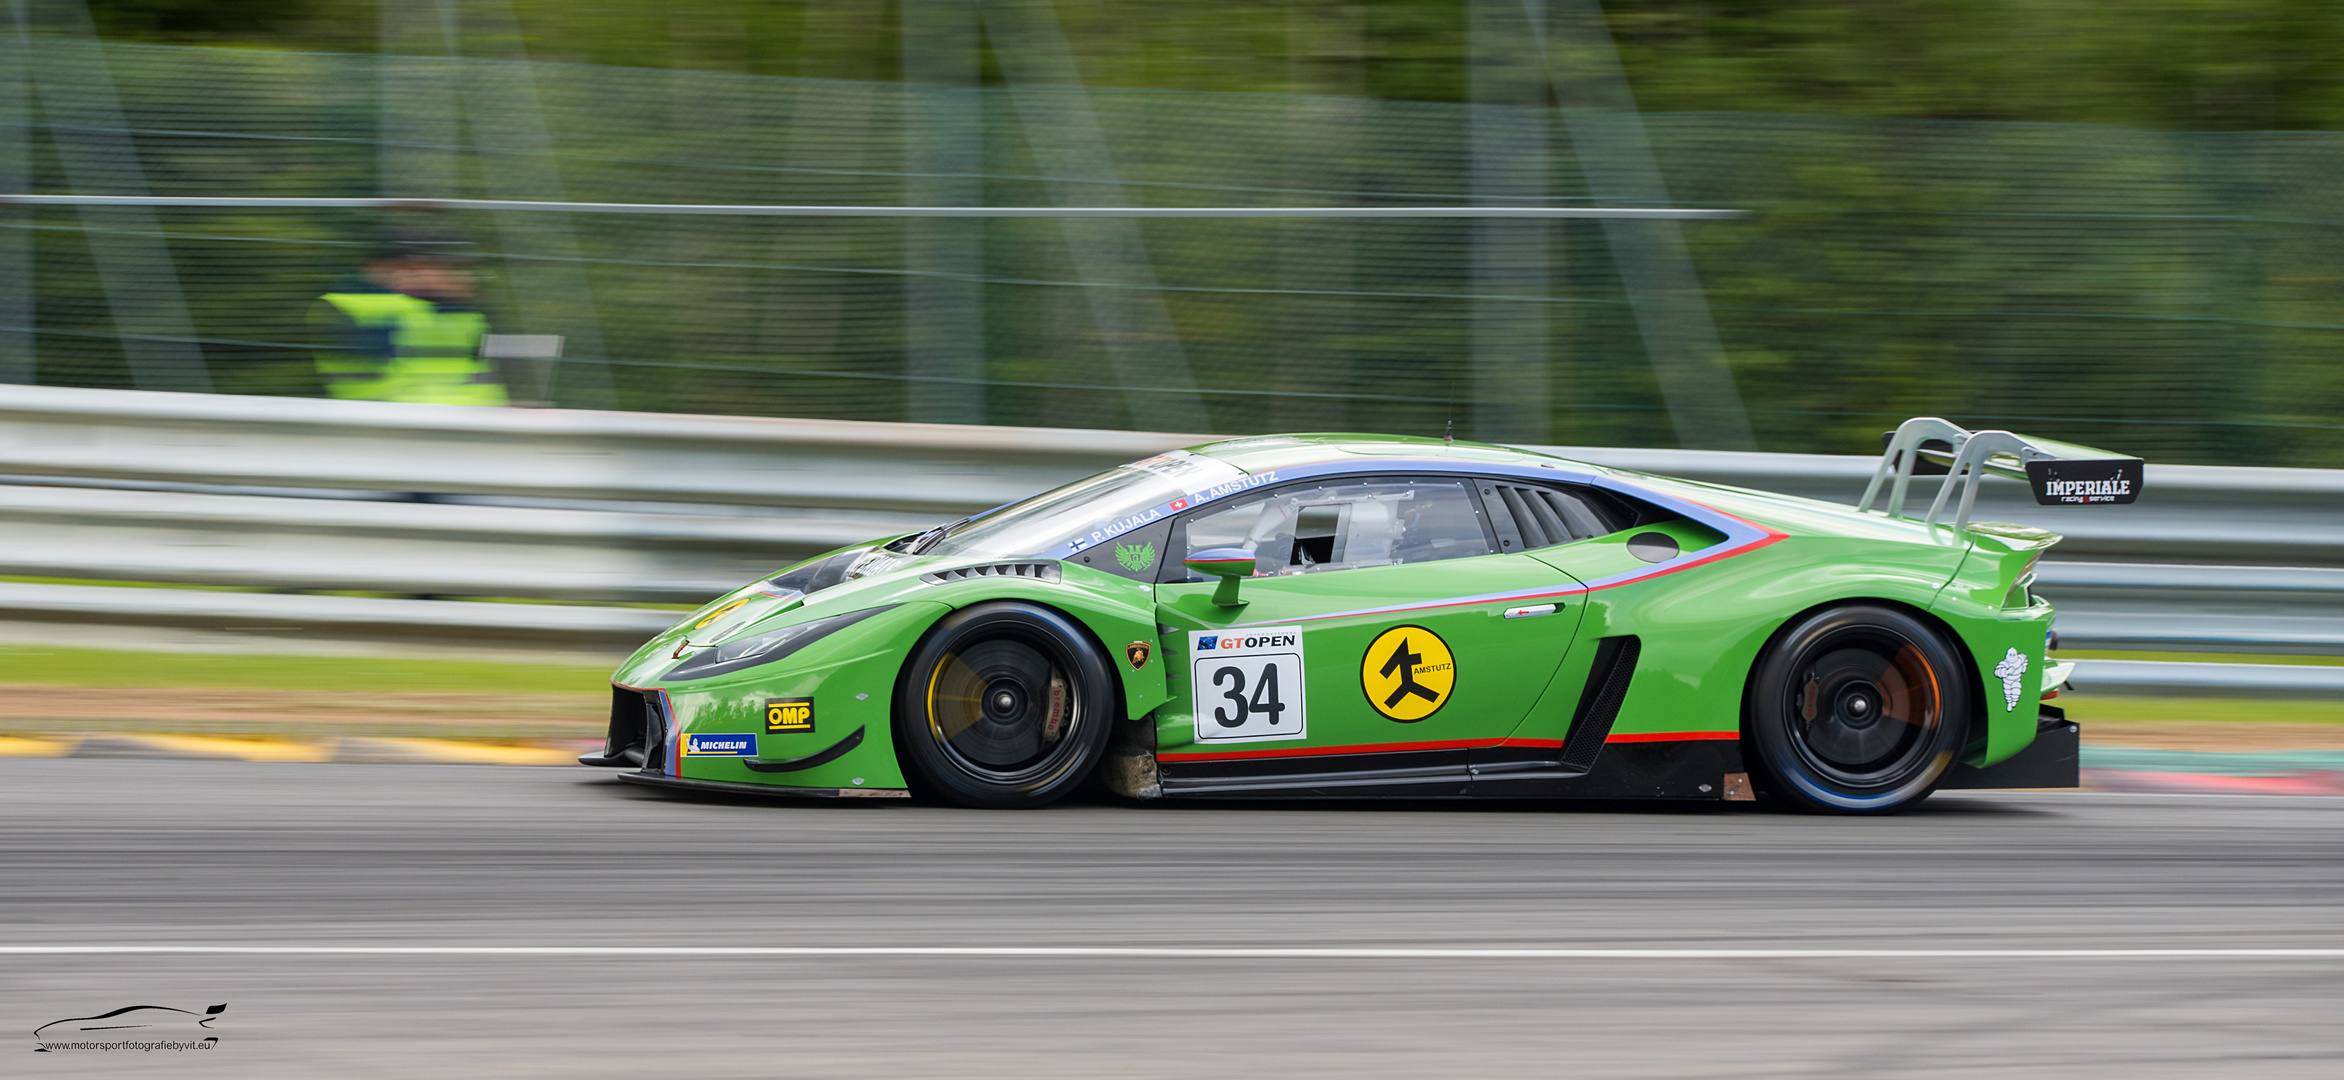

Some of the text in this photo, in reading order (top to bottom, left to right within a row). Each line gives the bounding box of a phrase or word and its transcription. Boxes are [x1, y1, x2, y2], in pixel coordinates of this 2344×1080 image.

[1210, 471, 1279, 498] AMSTUTZ
[2046, 480, 2131, 496] IMPERIALE
[1105, 508, 1161, 536] KUJALA
[1413, 662, 1452, 675] AMSTUTZ
[1213, 663, 1286, 728] 34
[768, 707, 810, 725] OMP
[1048, 689, 1062, 731] brembo
[700, 741, 747, 750] MICHELIN
